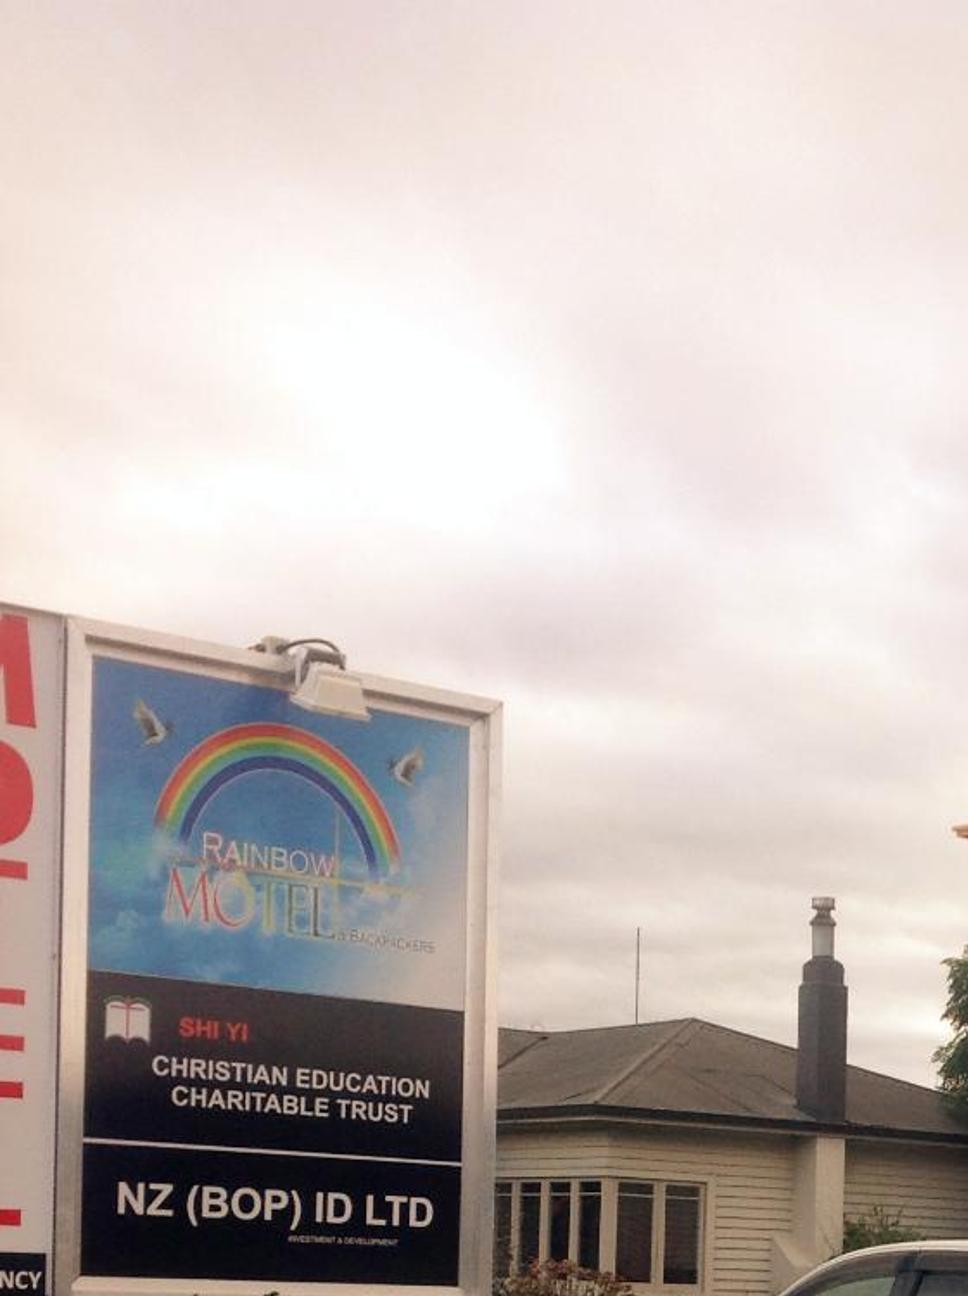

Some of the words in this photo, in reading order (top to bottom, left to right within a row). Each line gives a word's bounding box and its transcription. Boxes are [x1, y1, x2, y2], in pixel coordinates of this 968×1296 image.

[202, 831, 334, 878] RAINBOW
[163, 864, 337, 939] MOTEL
[178, 1016, 219, 1040] SHI
[225, 1022, 249, 1043] YI
[151, 1055, 288, 1086] CHRISTIAN
[295, 1068, 431, 1099] EDUCATION
[171, 1086, 330, 1118] CHARITABLE
[336, 1099, 414, 1124] TRUST
[116, 1181, 174, 1217] NZ
[186, 1184, 302, 1231] (BOP)
[315, 1191, 352, 1225] ID
[365, 1194, 434, 1228] LTD
